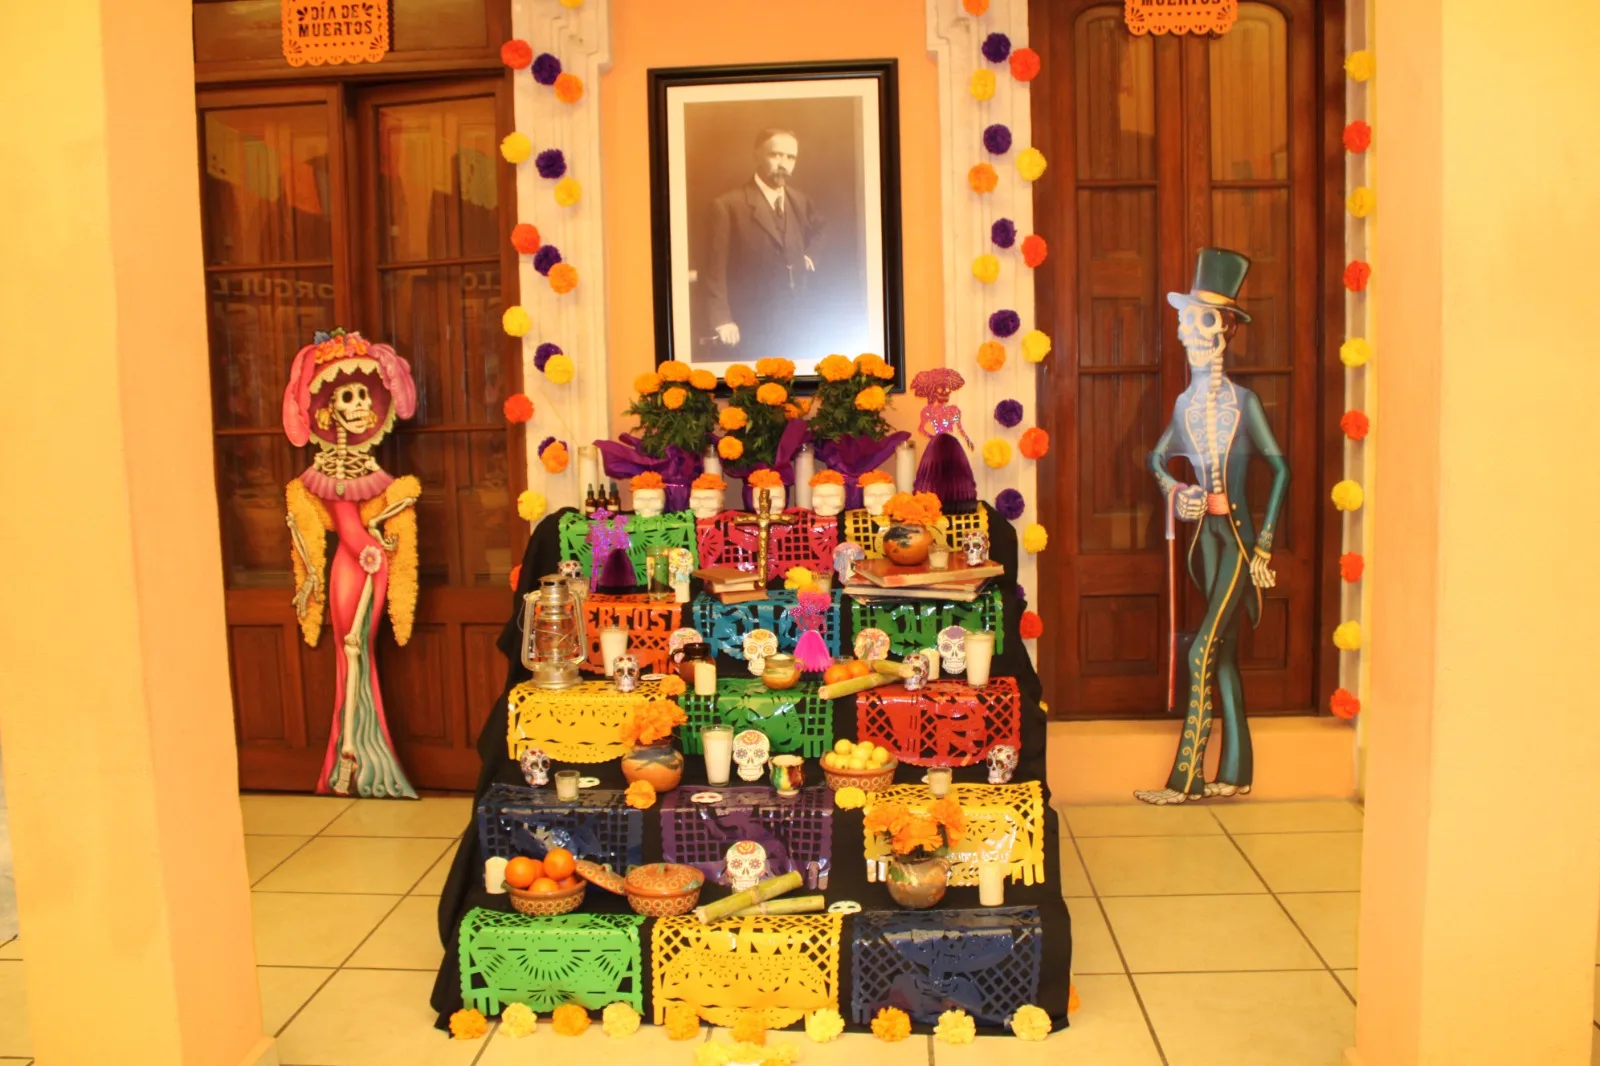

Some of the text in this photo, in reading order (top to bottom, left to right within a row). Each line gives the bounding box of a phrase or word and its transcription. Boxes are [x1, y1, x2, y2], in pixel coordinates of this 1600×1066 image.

[341, 4, 360, 19] DE
[298, 20, 373, 37] MUERTOS
[582, 606, 668, 633] ERTOS
